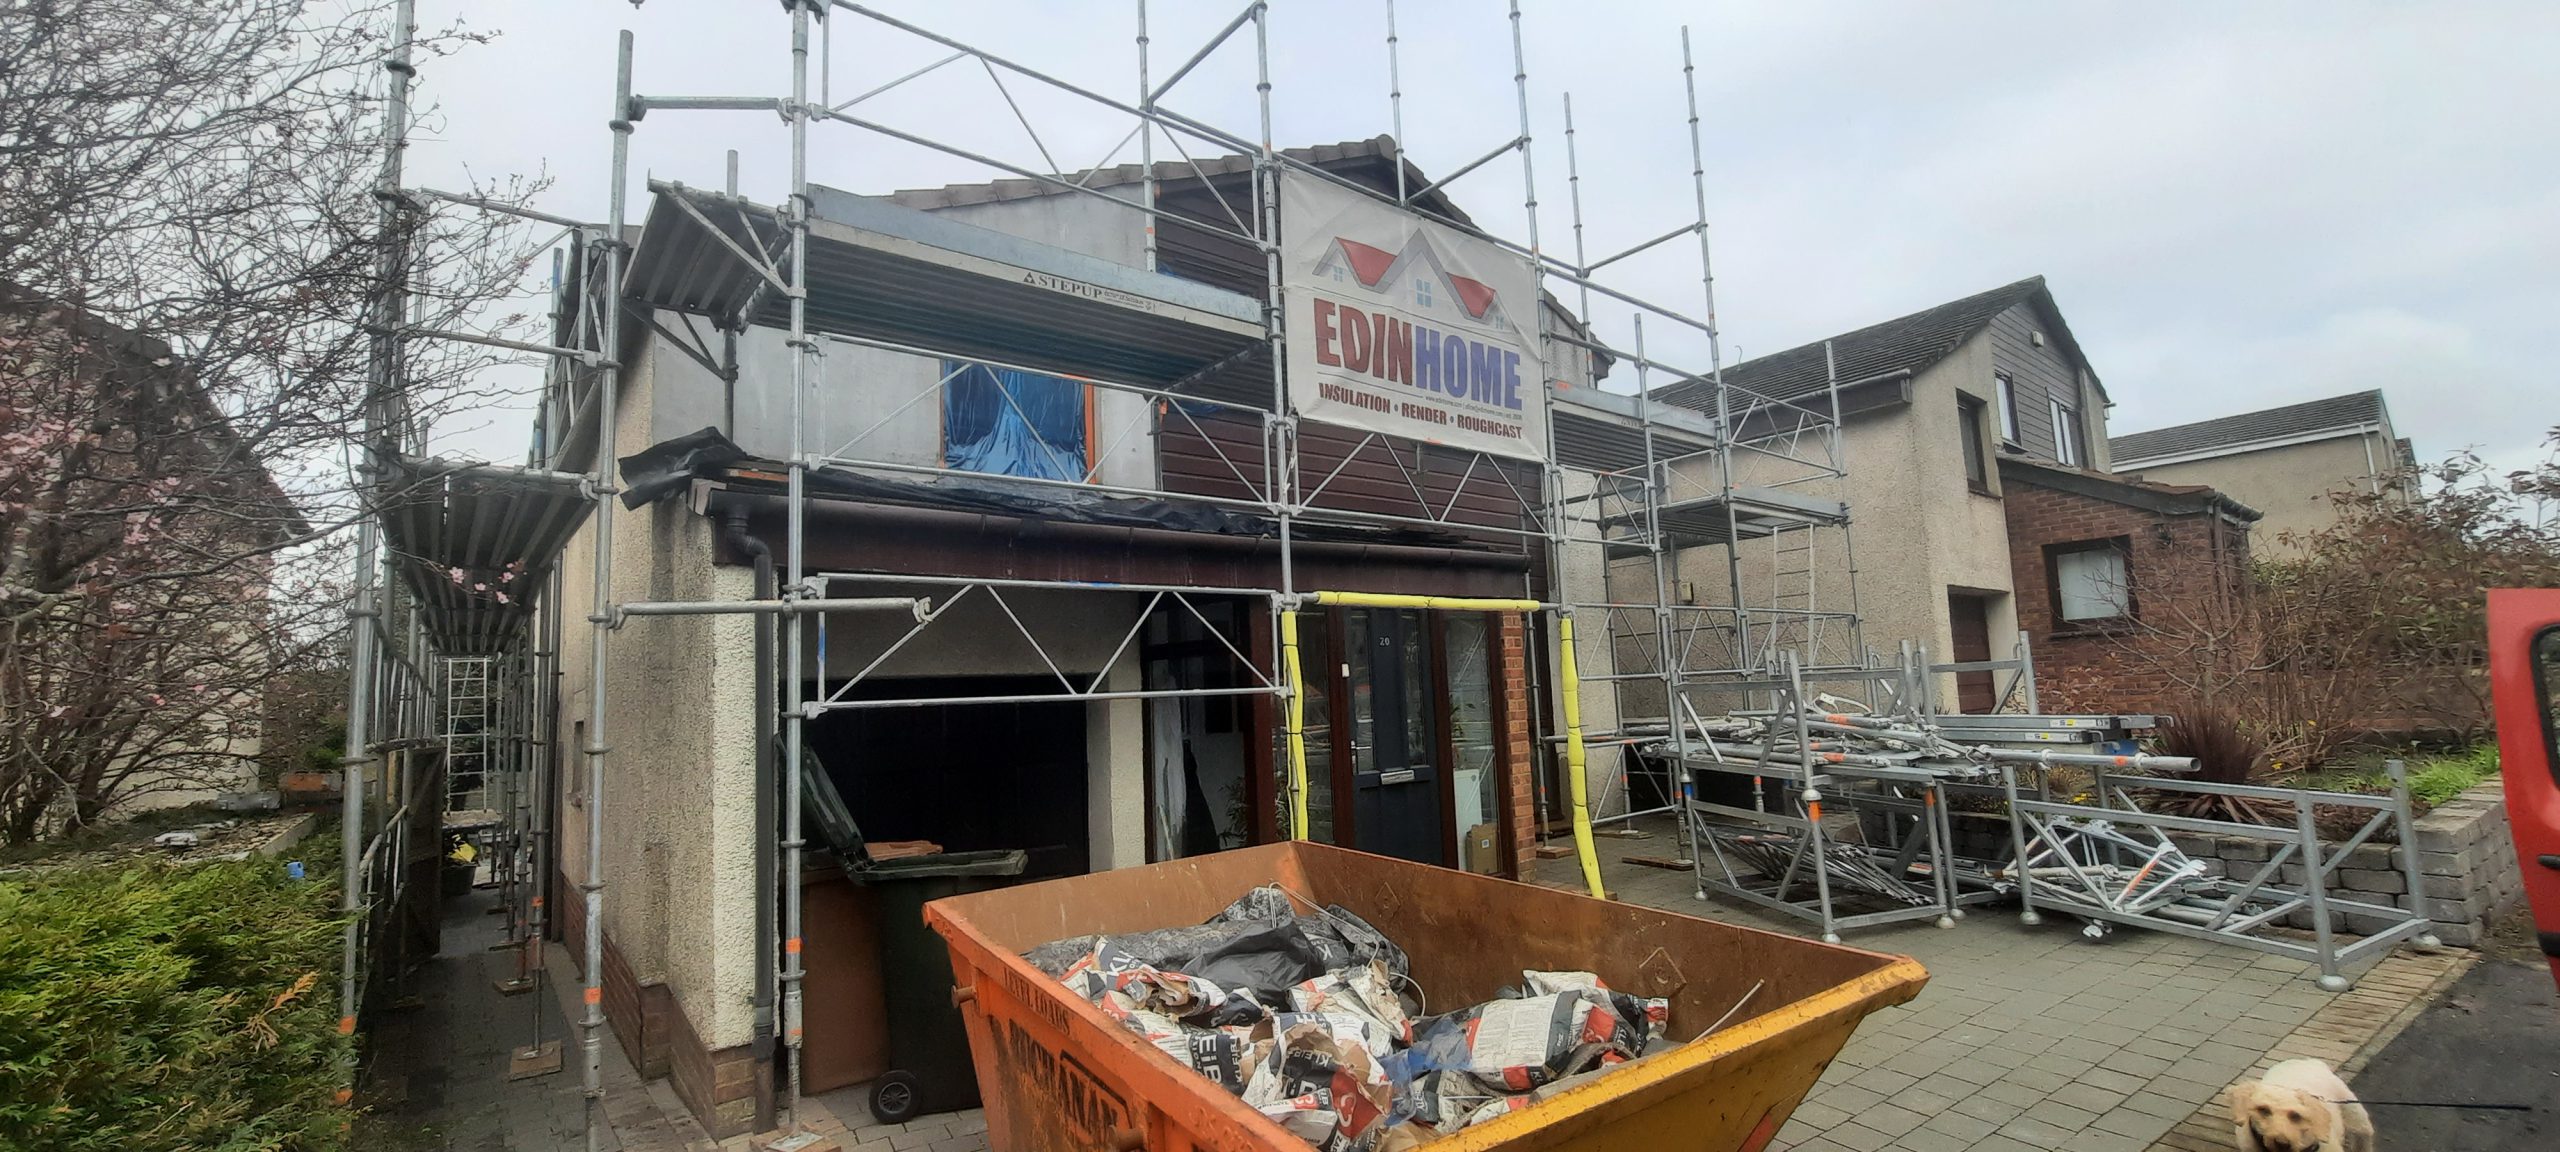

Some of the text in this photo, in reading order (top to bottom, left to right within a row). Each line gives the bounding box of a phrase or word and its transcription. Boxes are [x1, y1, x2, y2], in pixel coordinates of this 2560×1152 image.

[1038, 275, 1102, 299] STEPUP
[1314, 297, 1523, 411] EDINHOME
[1318, 382, 1391, 414] INSULATION
[1401, 402, 1447, 425] RENDER
[1457, 414, 1522, 439] ROUGHCAST
